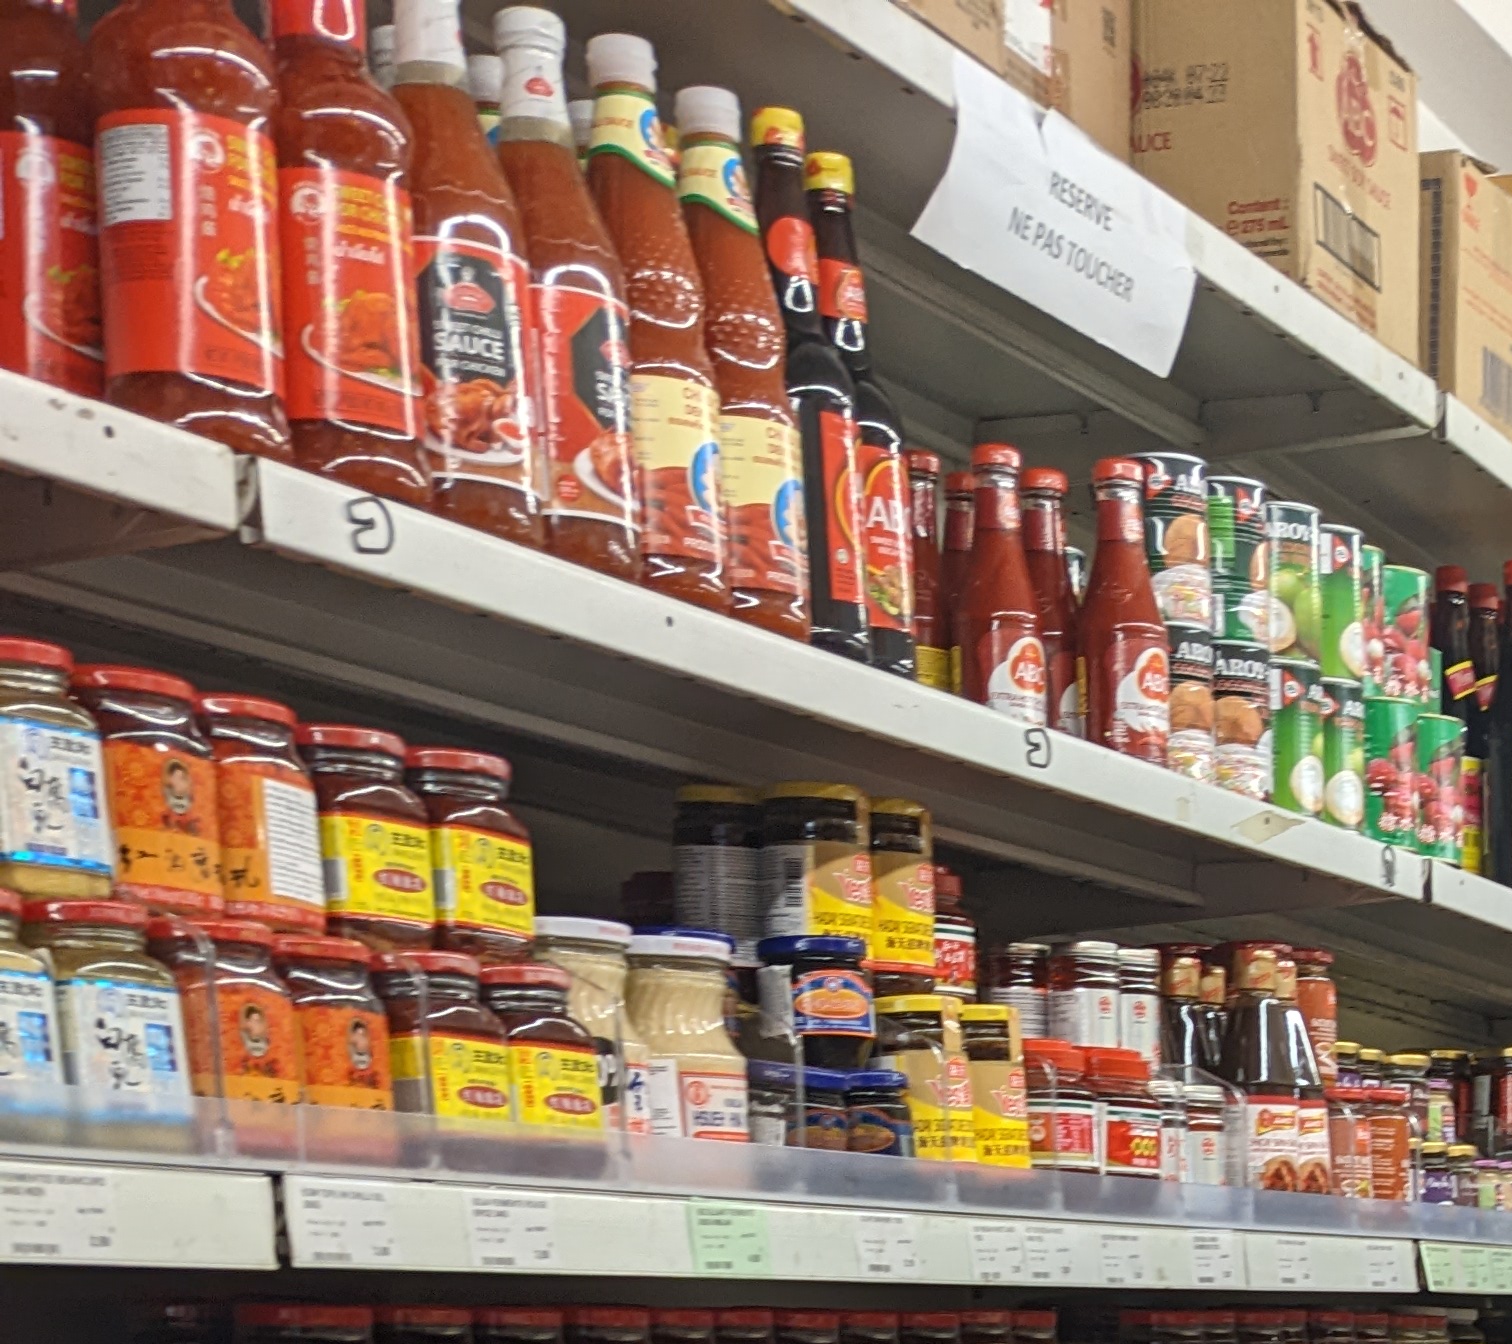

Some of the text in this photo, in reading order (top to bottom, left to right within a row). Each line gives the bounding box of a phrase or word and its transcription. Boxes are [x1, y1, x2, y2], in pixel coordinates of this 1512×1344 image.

[1049, 170, 1114, 232] RESERVE
[1007, 206, 1135, 303] NE PAS TOUCHER
[434, 333, 505, 361] SAUCE
